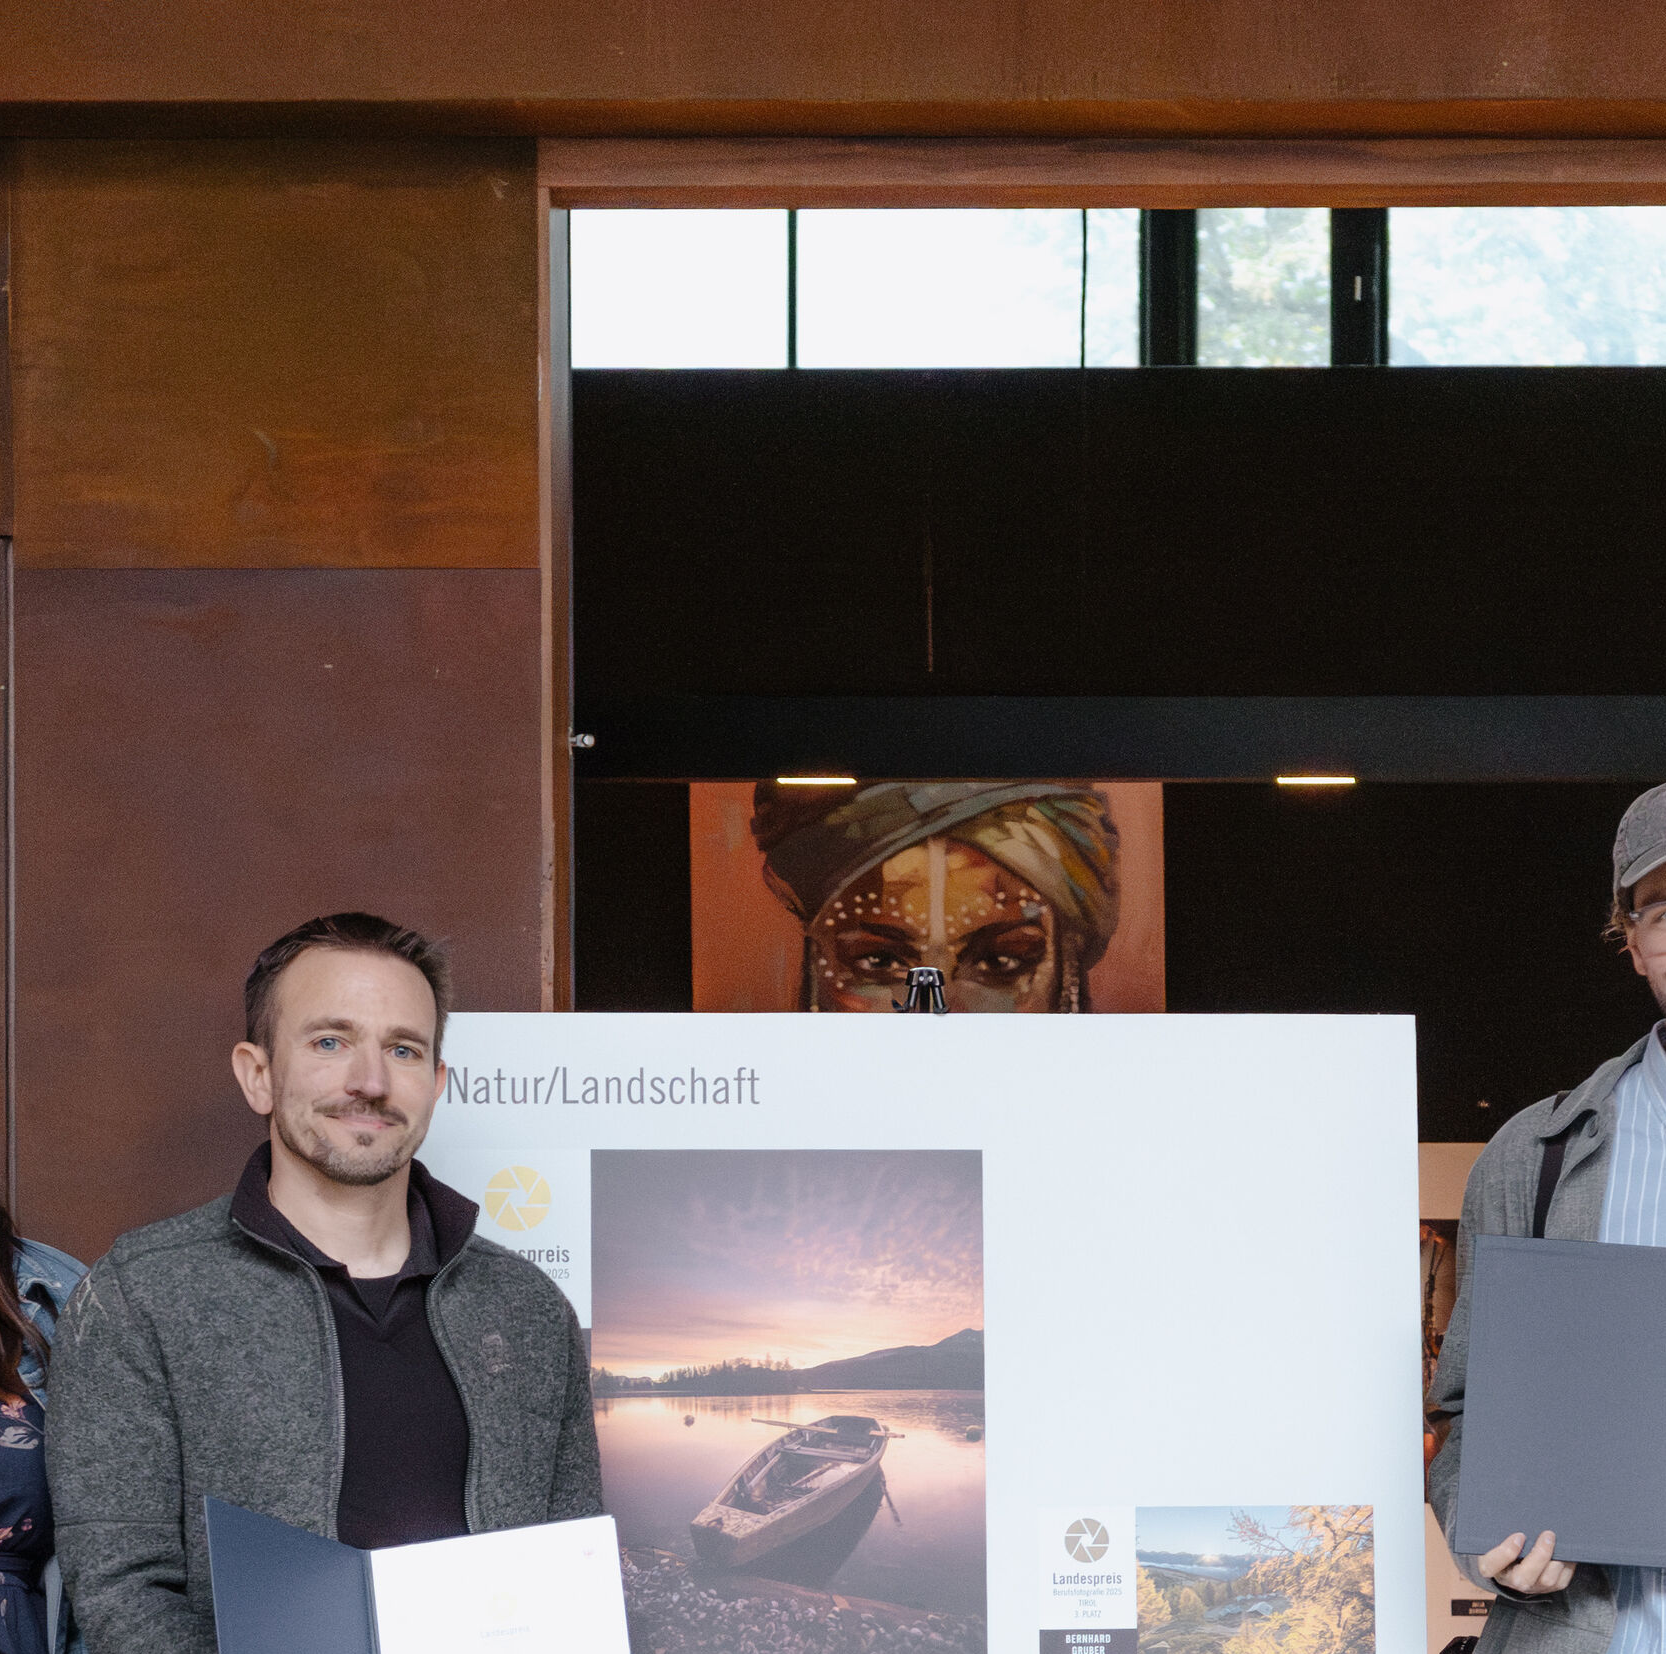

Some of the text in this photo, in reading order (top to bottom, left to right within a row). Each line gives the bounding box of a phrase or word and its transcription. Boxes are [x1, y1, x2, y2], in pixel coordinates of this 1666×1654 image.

[446, 1066, 760, 1105] Natur/Landschaft
[1053, 1572, 1122, 1587] Landespreis
[1053, 1588, 1122, 1597] Berufsfotografie 2025
[1079, 1599, 1097, 1607] TIROL
[1082, 1610, 1102, 1618] PLATZ
[1065, 1634, 1111, 1644] BERNHARD
